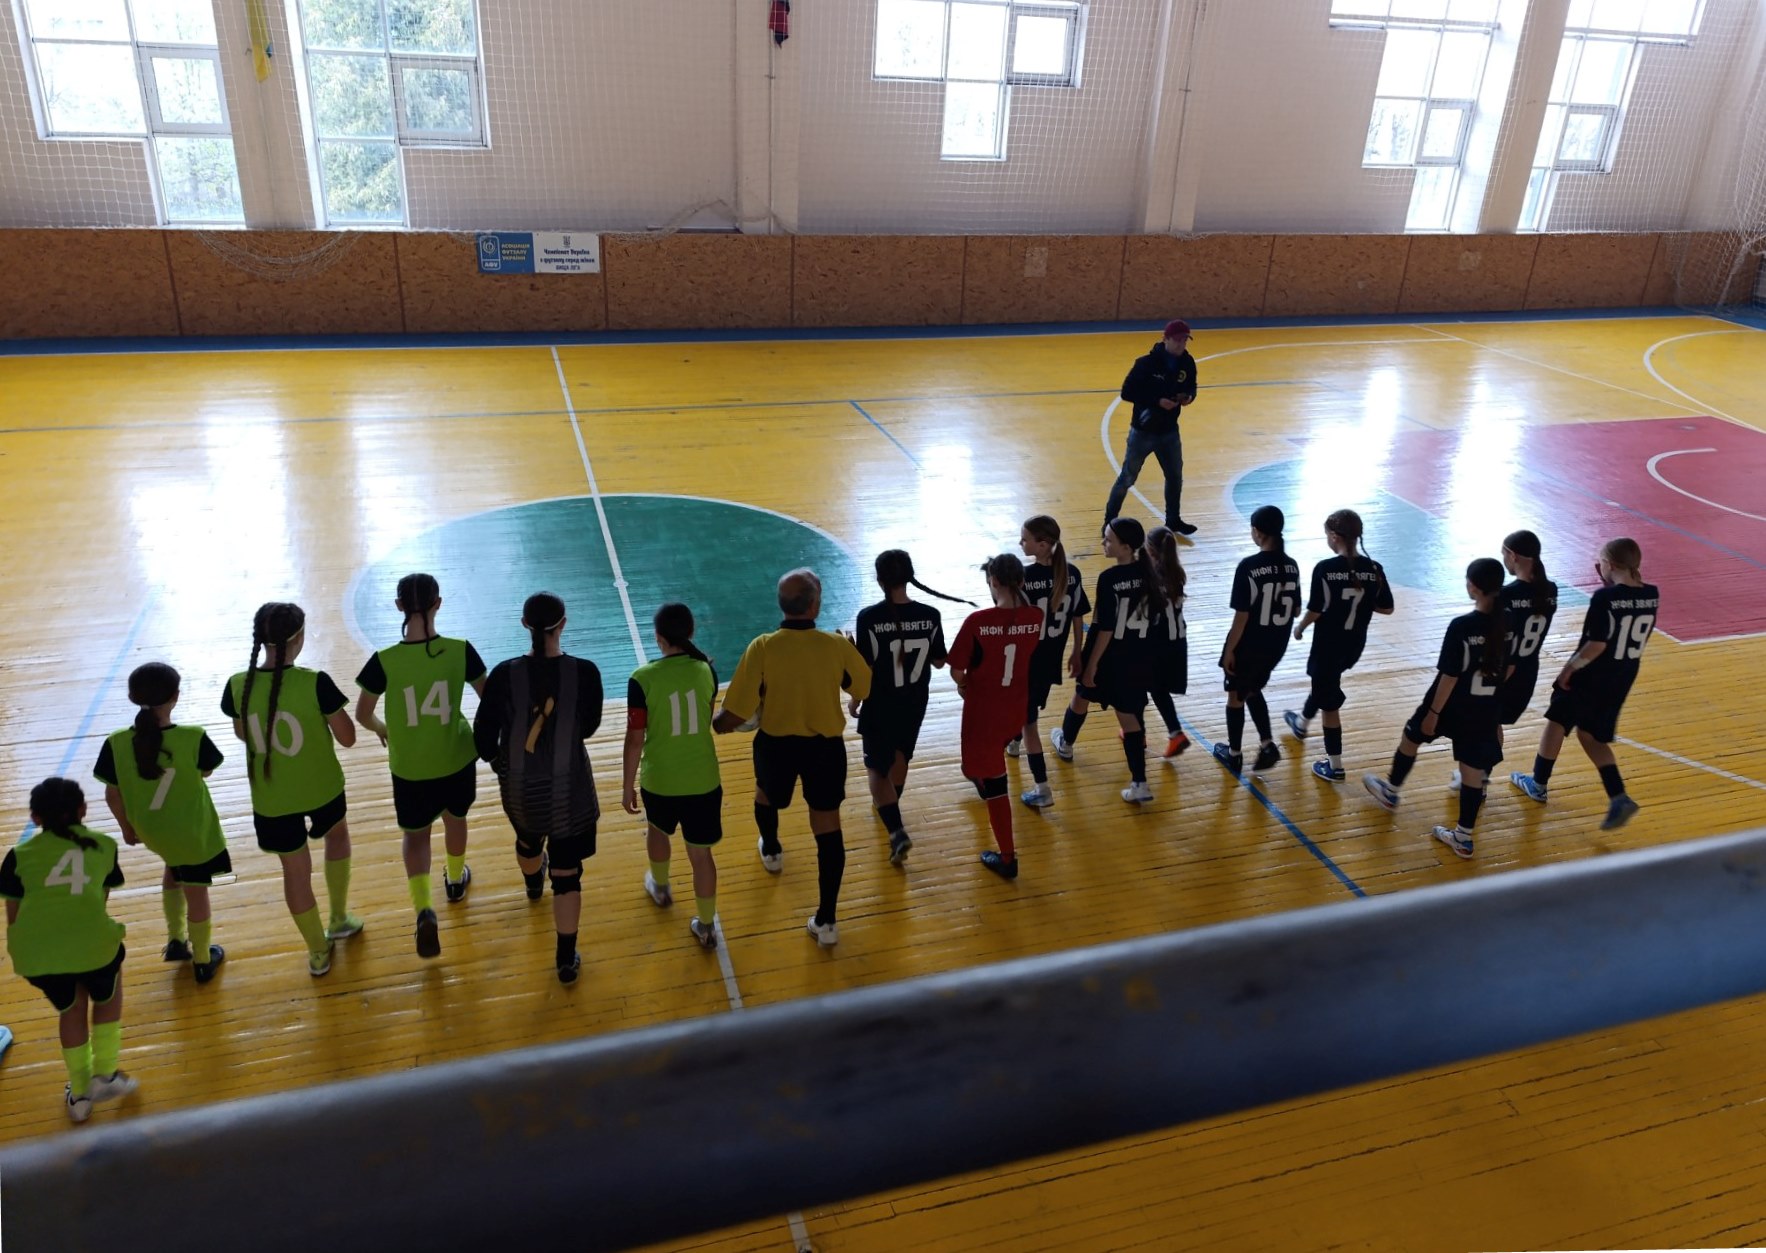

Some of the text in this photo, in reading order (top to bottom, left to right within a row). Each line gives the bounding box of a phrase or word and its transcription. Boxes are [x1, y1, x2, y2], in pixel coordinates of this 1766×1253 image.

[1025, 579, 1047, 591] ЖФК
[1326, 572, 1349, 581] ЖФК
[1037, 594, 1071, 641] 13
[1114, 595, 1150, 640] 14
[1259, 581, 1296, 627] 15
[1341, 587, 1365, 631] 7
[873, 621, 897, 634] ЖФК
[979, 625, 1003, 636] ЖФК
[1518, 614, 1547, 657] 8
[1614, 614, 1655, 660] 19
[889, 637, 930, 688] 17
[1001, 643, 1017, 687] 1
[403, 680, 453, 728] 14
[669, 688, 699, 737] 11
[247, 711, 304, 757] 10
[44, 848, 92, 896] 4
